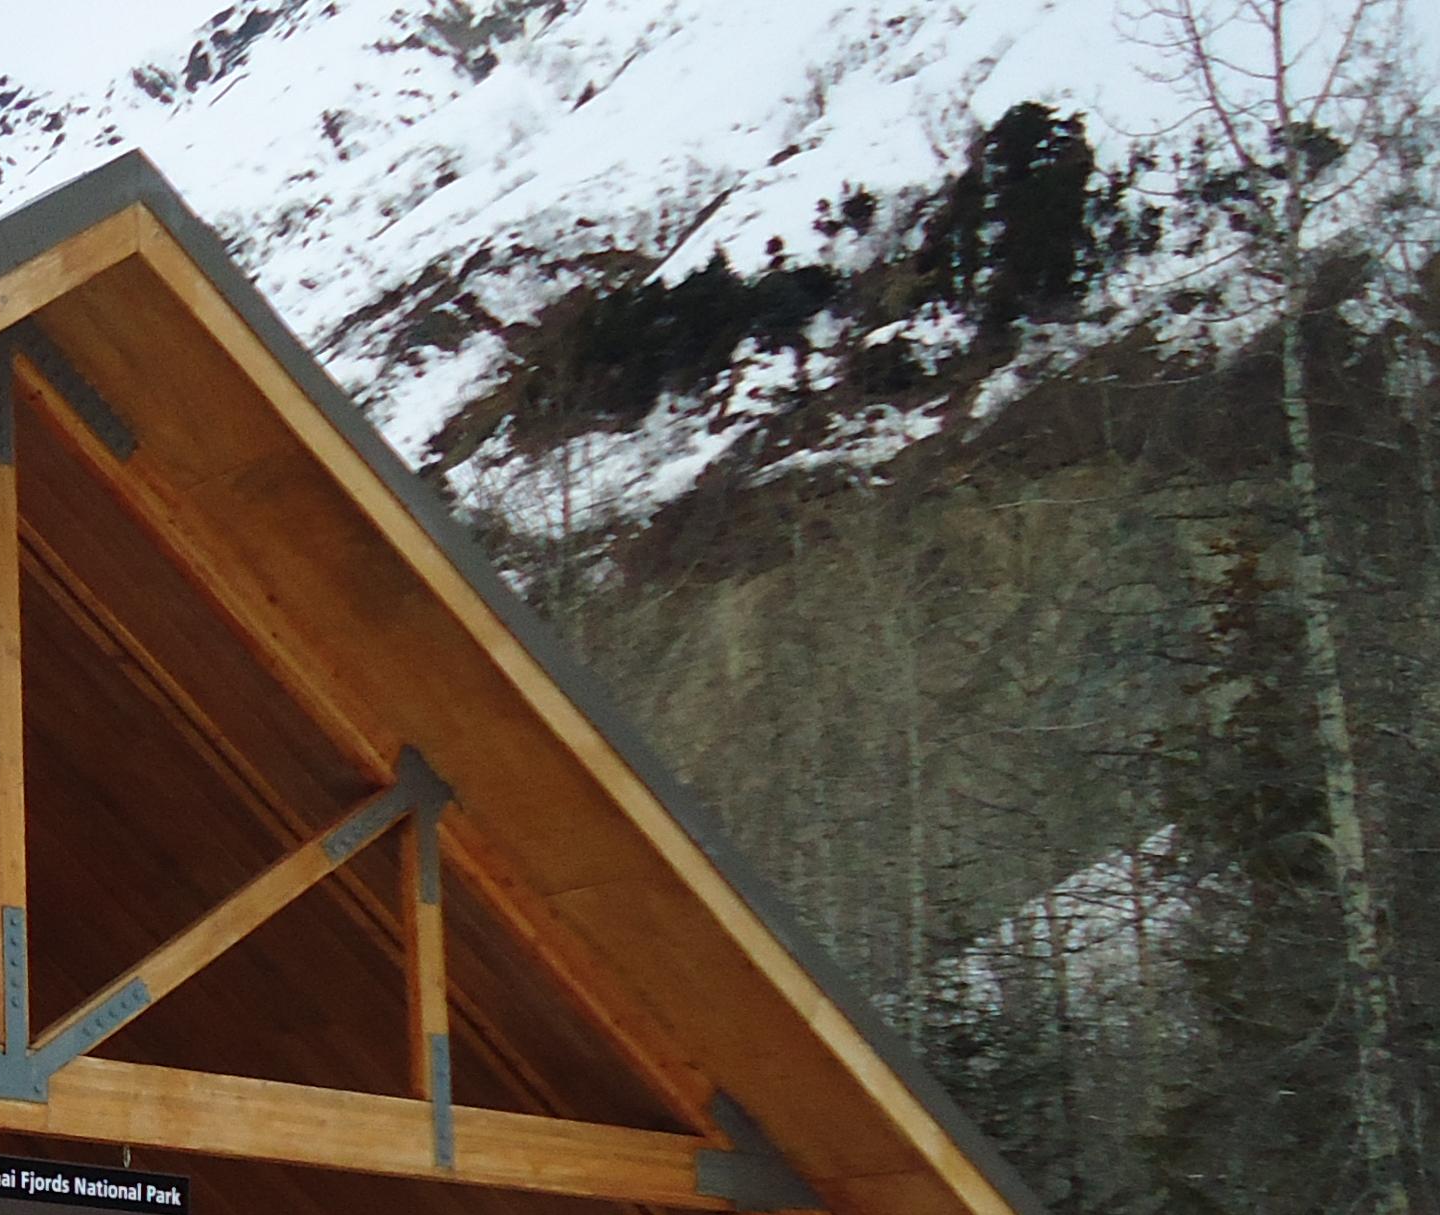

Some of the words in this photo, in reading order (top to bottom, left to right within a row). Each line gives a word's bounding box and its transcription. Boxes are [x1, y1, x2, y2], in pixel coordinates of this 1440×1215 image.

[20, 1171, 71, 1193] Fjords
[73, 1177, 143, 1200] National
[145, 1185, 182, 1205] Park
